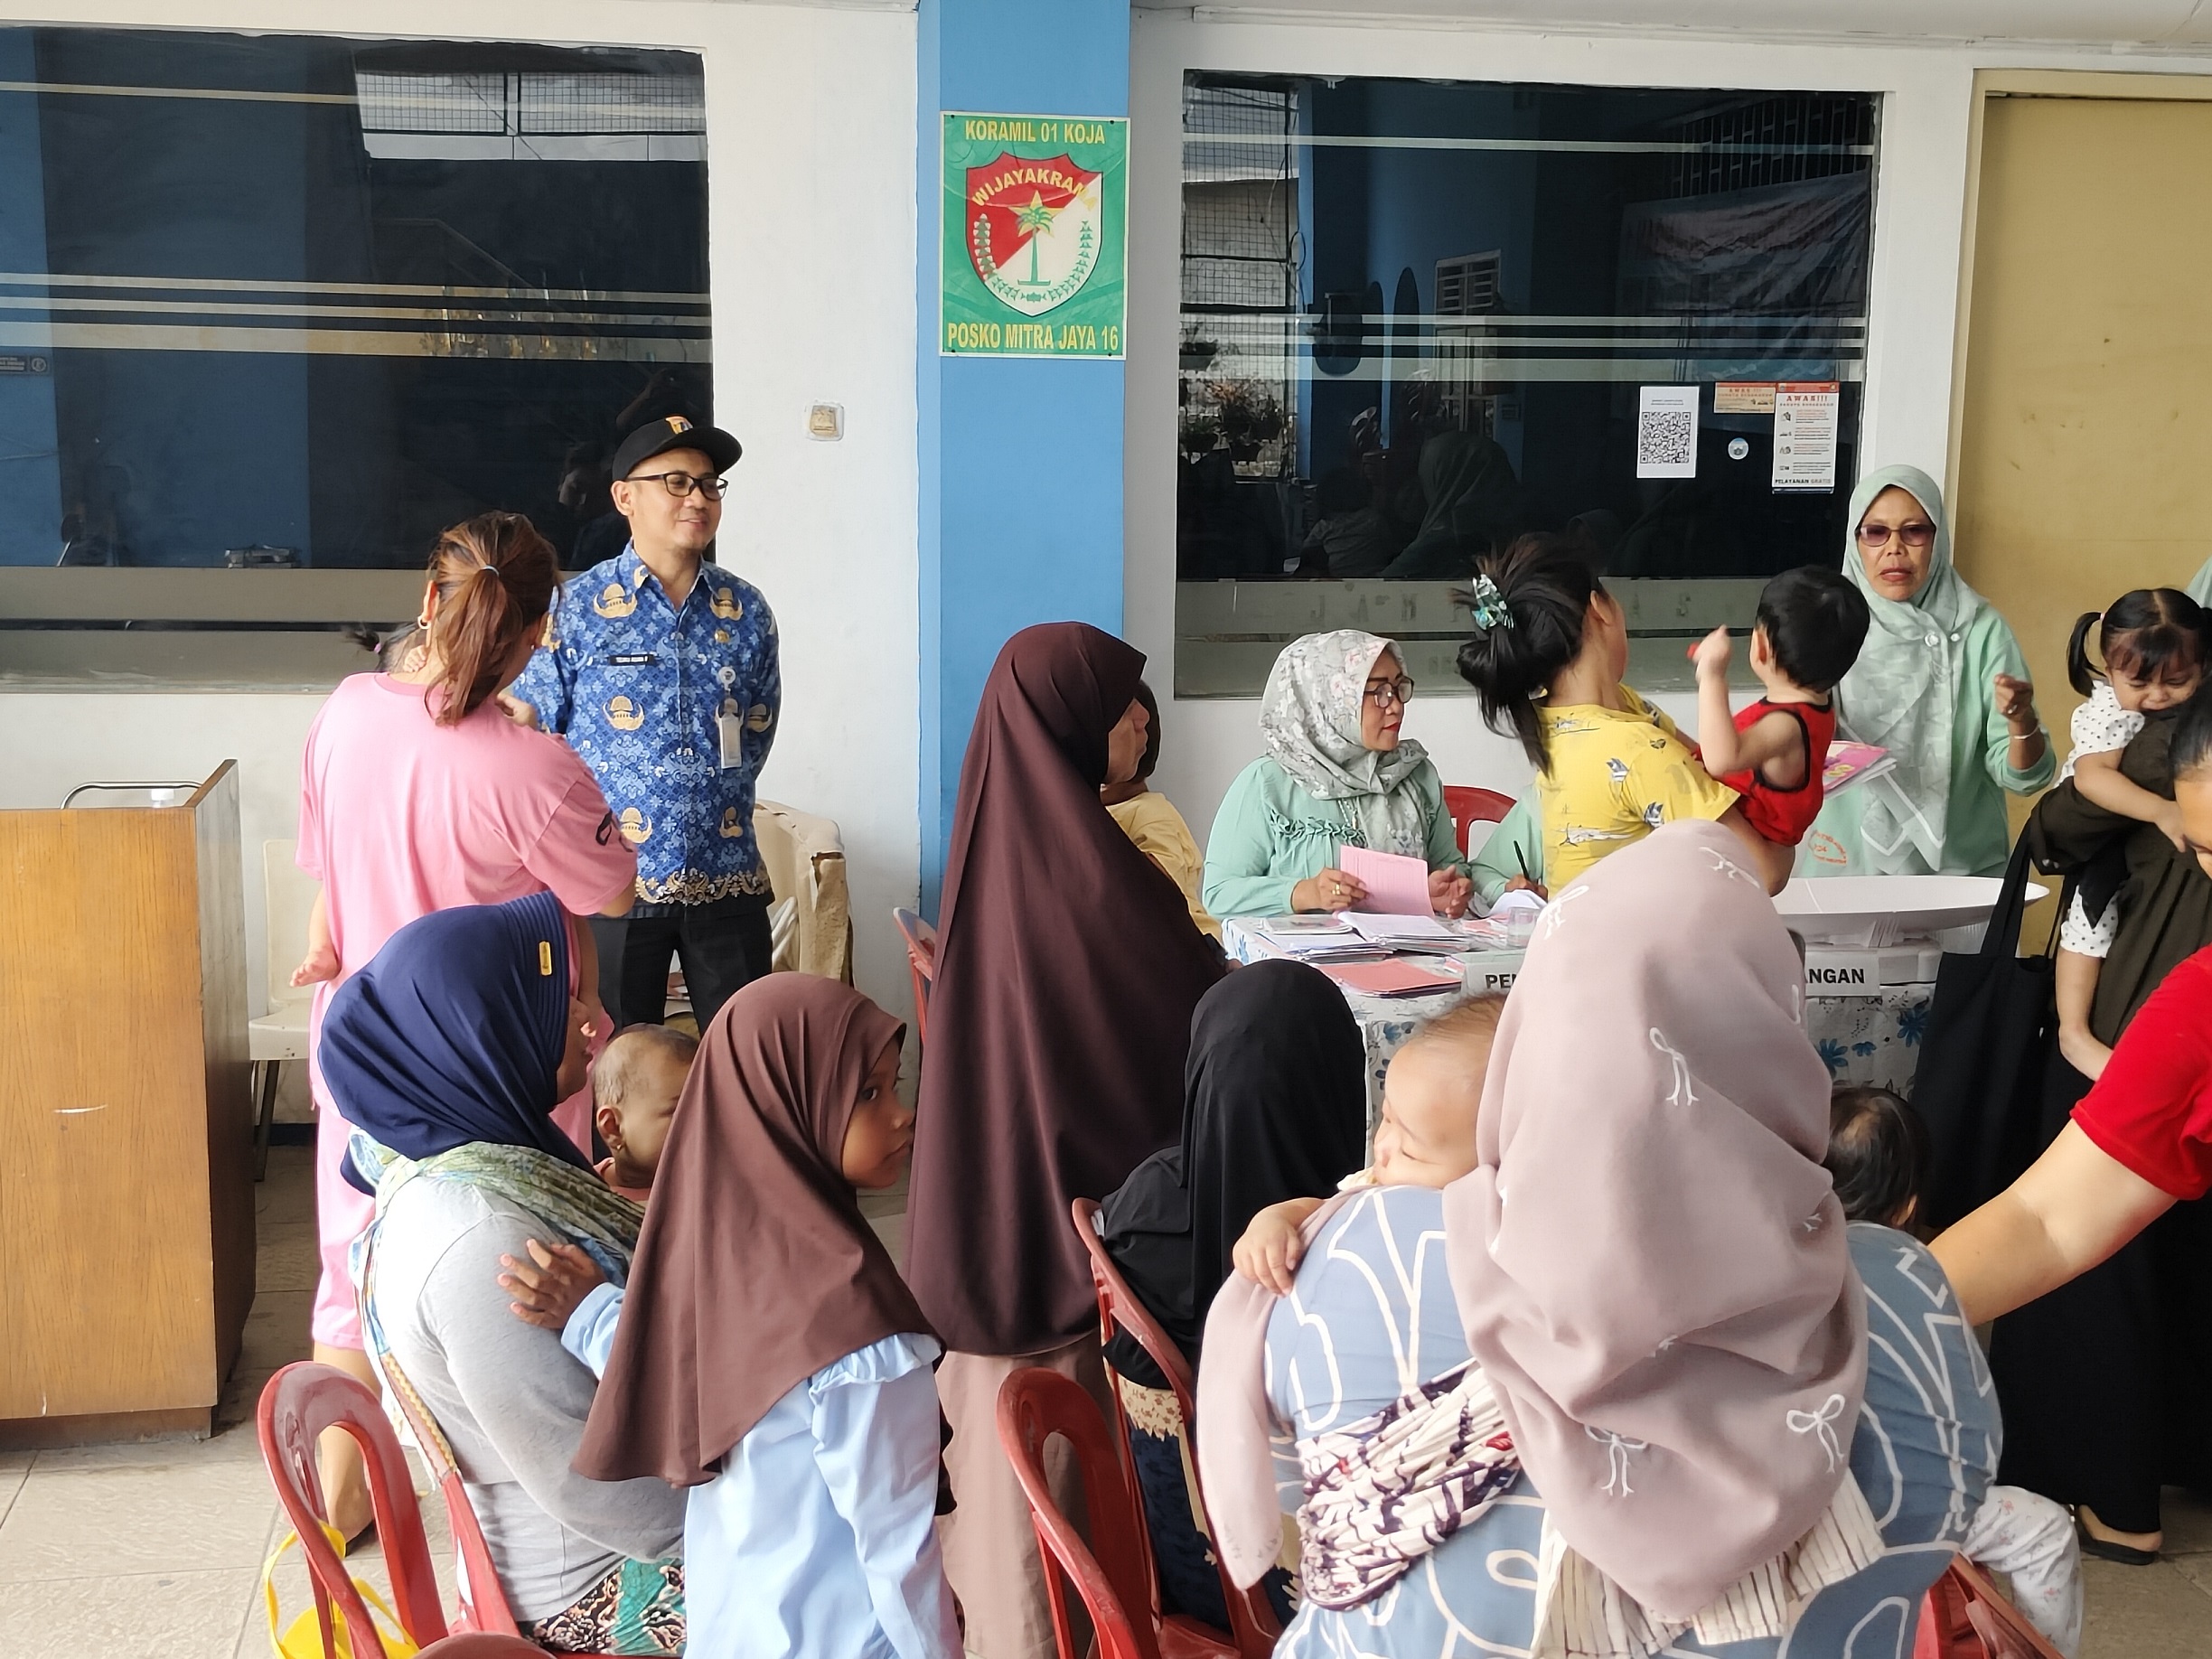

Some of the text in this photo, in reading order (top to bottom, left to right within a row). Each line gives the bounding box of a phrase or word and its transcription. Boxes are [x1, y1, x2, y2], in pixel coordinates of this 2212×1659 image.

[965, 119, 1105, 145] KORAMIL 01 KOJA
[948, 322, 1119, 351] POSKO MITRA JAYA 16
